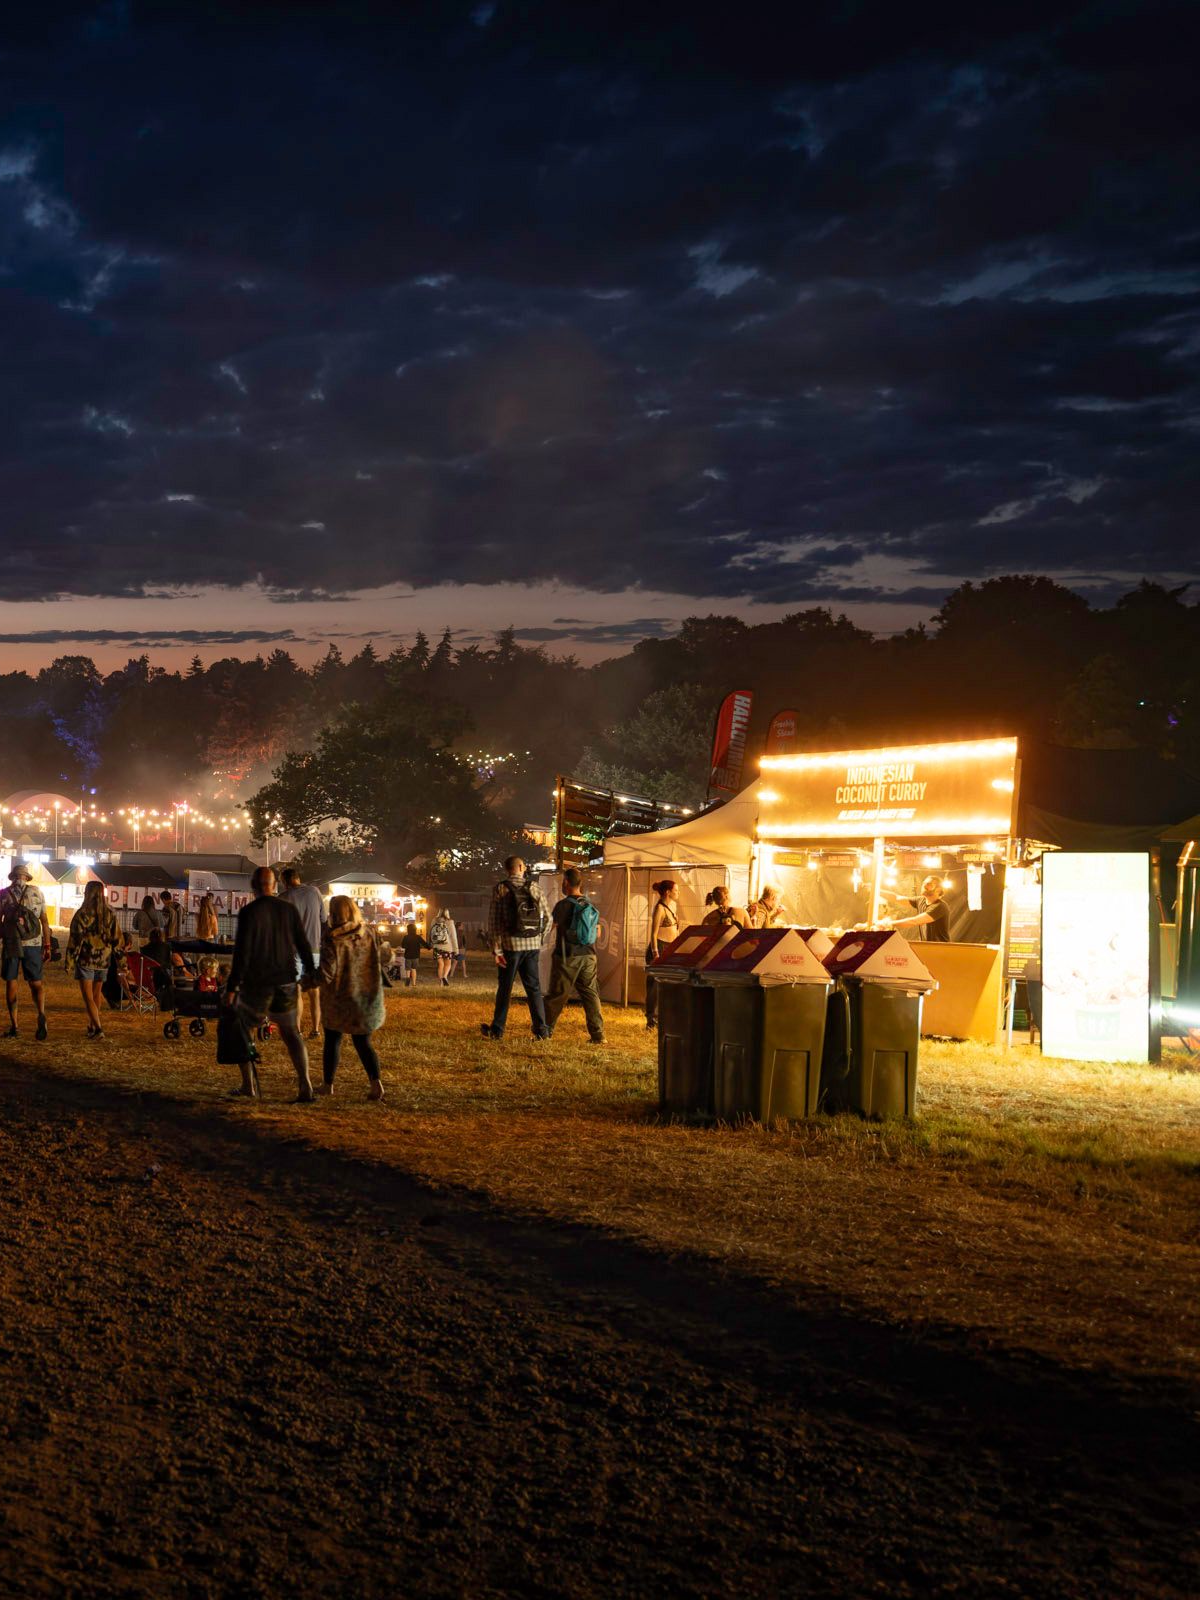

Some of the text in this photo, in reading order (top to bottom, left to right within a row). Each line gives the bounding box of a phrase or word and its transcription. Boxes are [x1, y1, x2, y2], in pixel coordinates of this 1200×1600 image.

[726, 694, 752, 772] HALLOUMI
[846, 763, 915, 785] INDONESIAN
[835, 782, 927, 804] COCONUT CURRY
